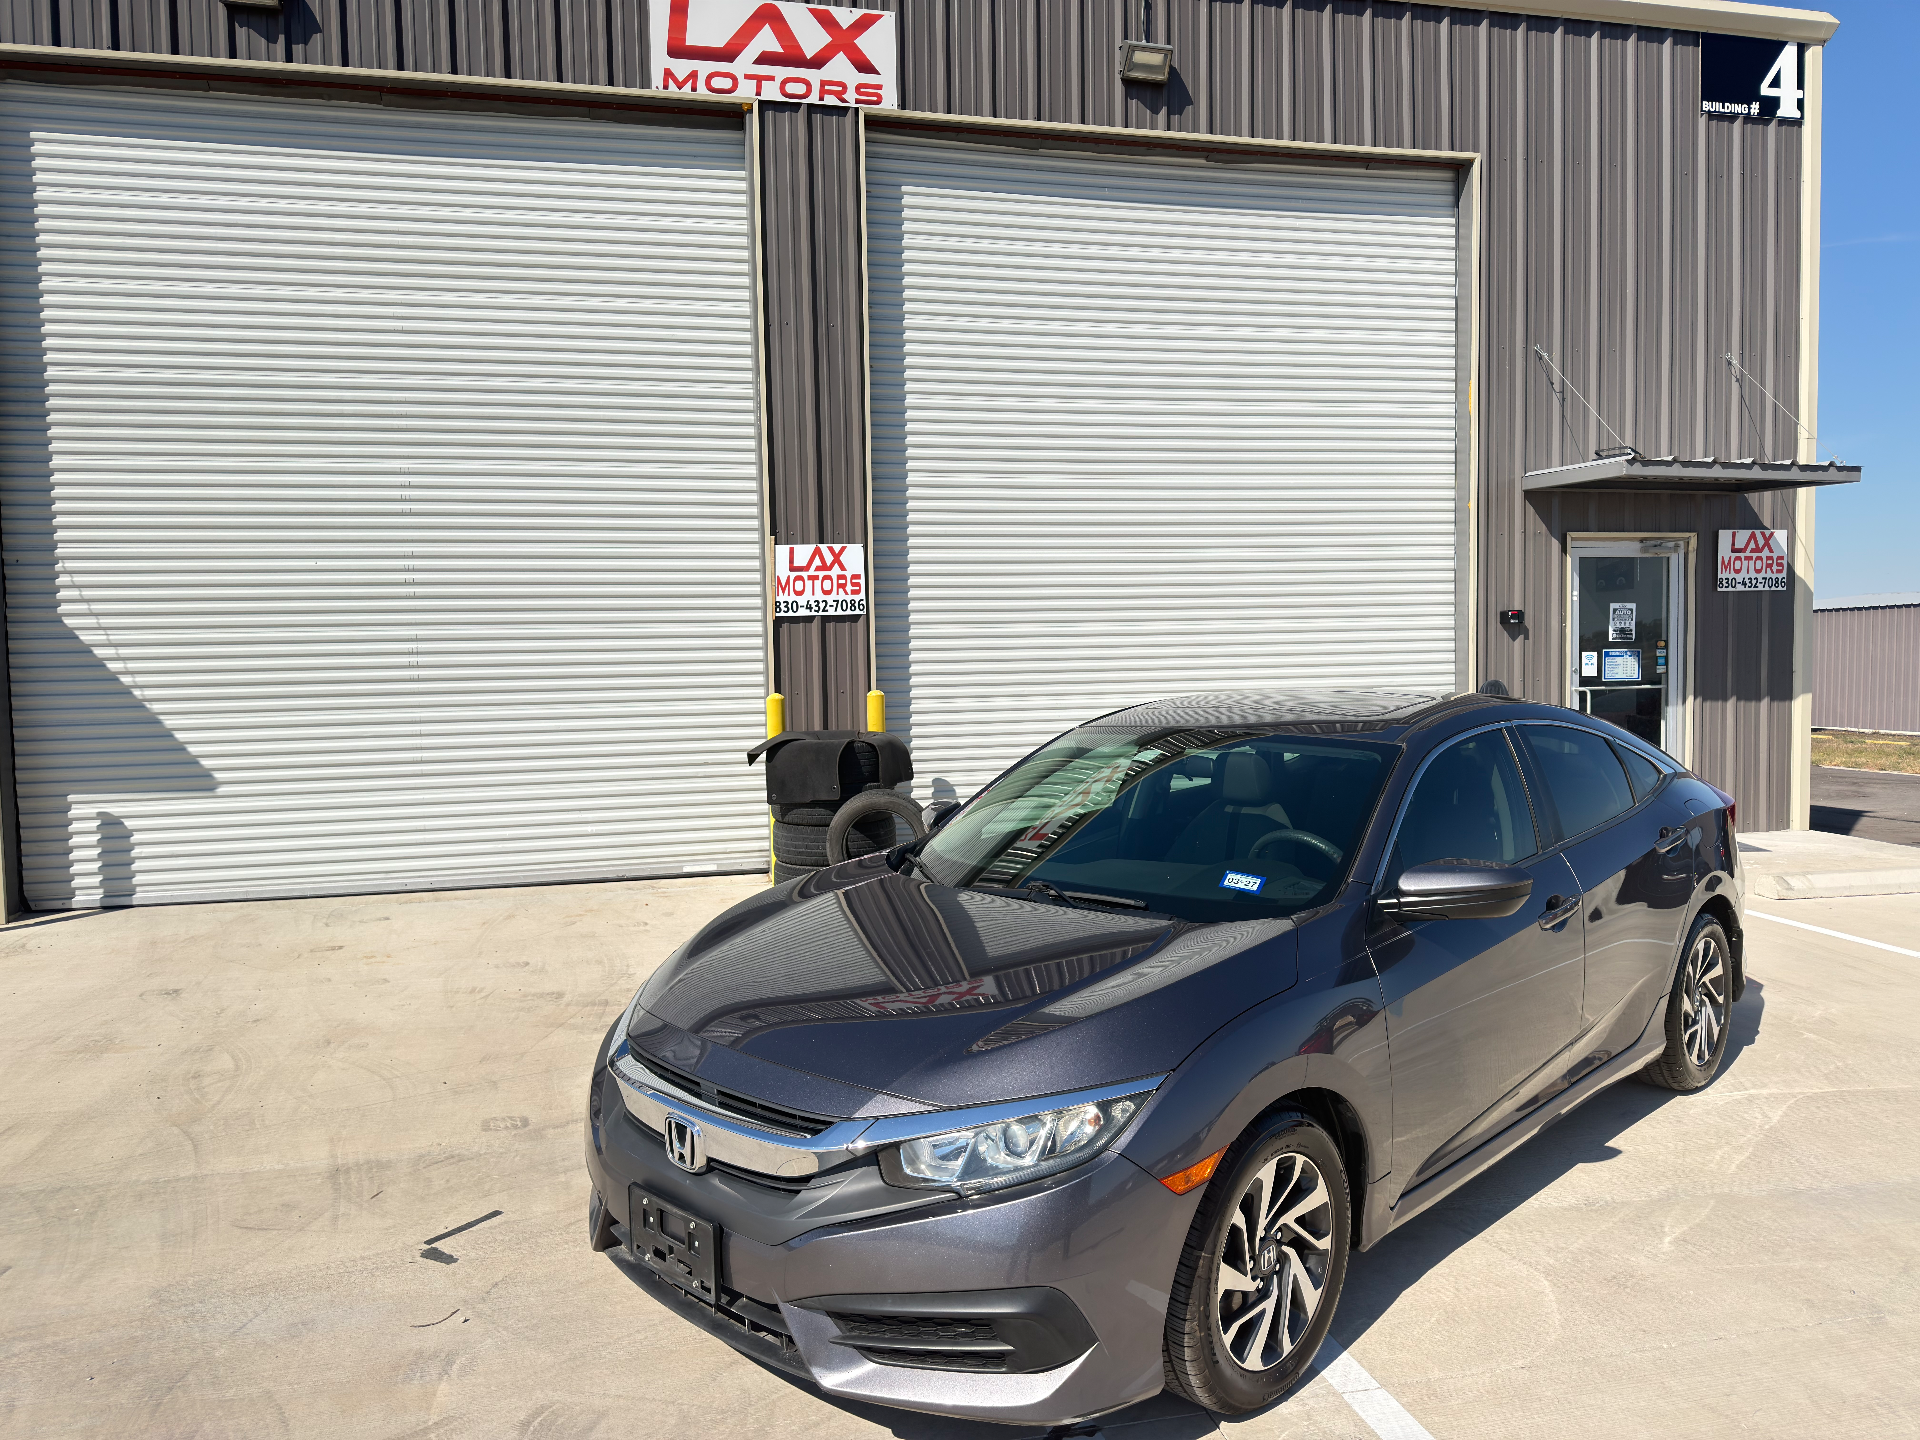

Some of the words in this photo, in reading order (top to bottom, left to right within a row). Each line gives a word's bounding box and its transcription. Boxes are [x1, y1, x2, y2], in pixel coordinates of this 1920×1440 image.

[667, 0, 885, 75] LAX
[662, 67, 883, 106] MOTORS
[1702, 101, 1749, 114] BUILDING
[1760, 41, 1804, 118] 4
[1731, 531, 1776, 553] LAX
[789, 546, 847, 572] LAX
[1720, 555, 1785, 575] MOTORS
[776, 574, 861, 597] MOTORS
[1718, 576, 1786, 589] 830-432-7086
[775, 599, 865, 614] 830-432-7086
